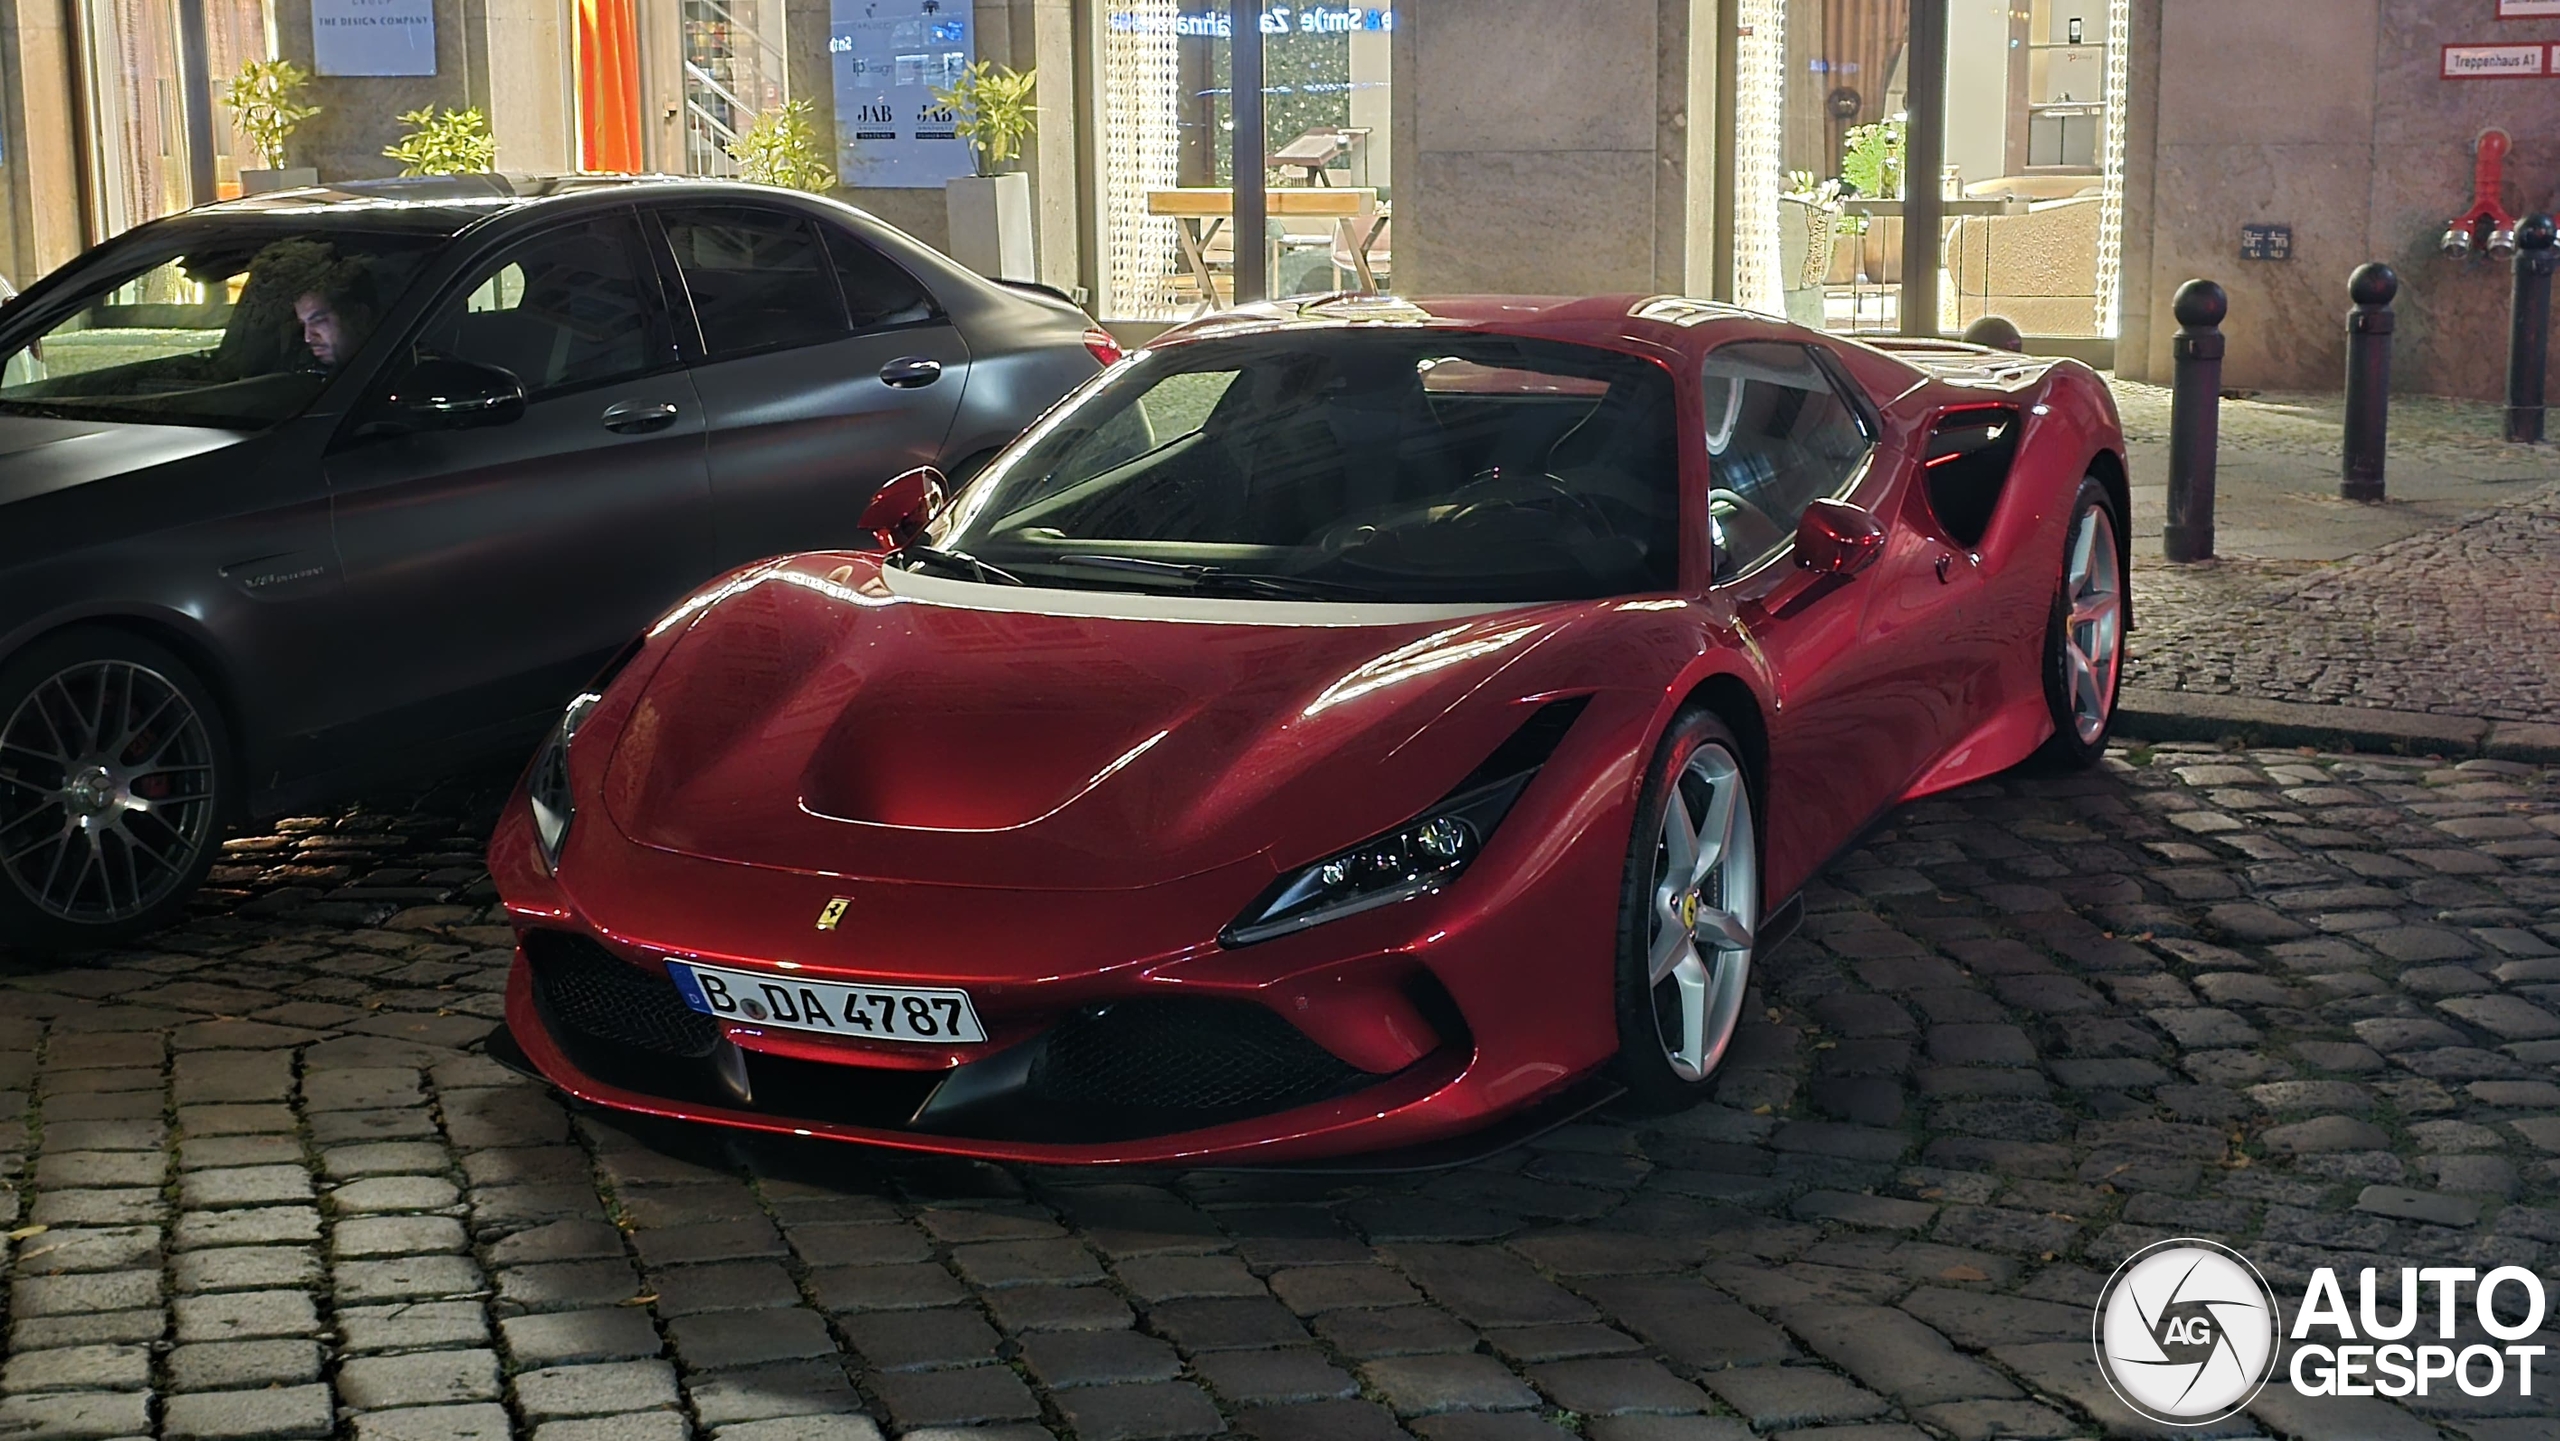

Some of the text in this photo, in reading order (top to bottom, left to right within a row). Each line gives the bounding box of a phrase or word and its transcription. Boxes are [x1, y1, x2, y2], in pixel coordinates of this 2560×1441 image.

[319, 16, 428, 26] THE DESIGN COMPANY
[2454, 54, 2520, 70] Treppenhaus
[2523, 54, 2536, 66] A1
[857, 104, 893, 123] JAB
[916, 104, 953, 123] JAB
[697, 973, 963, 1037] B DA 4787
